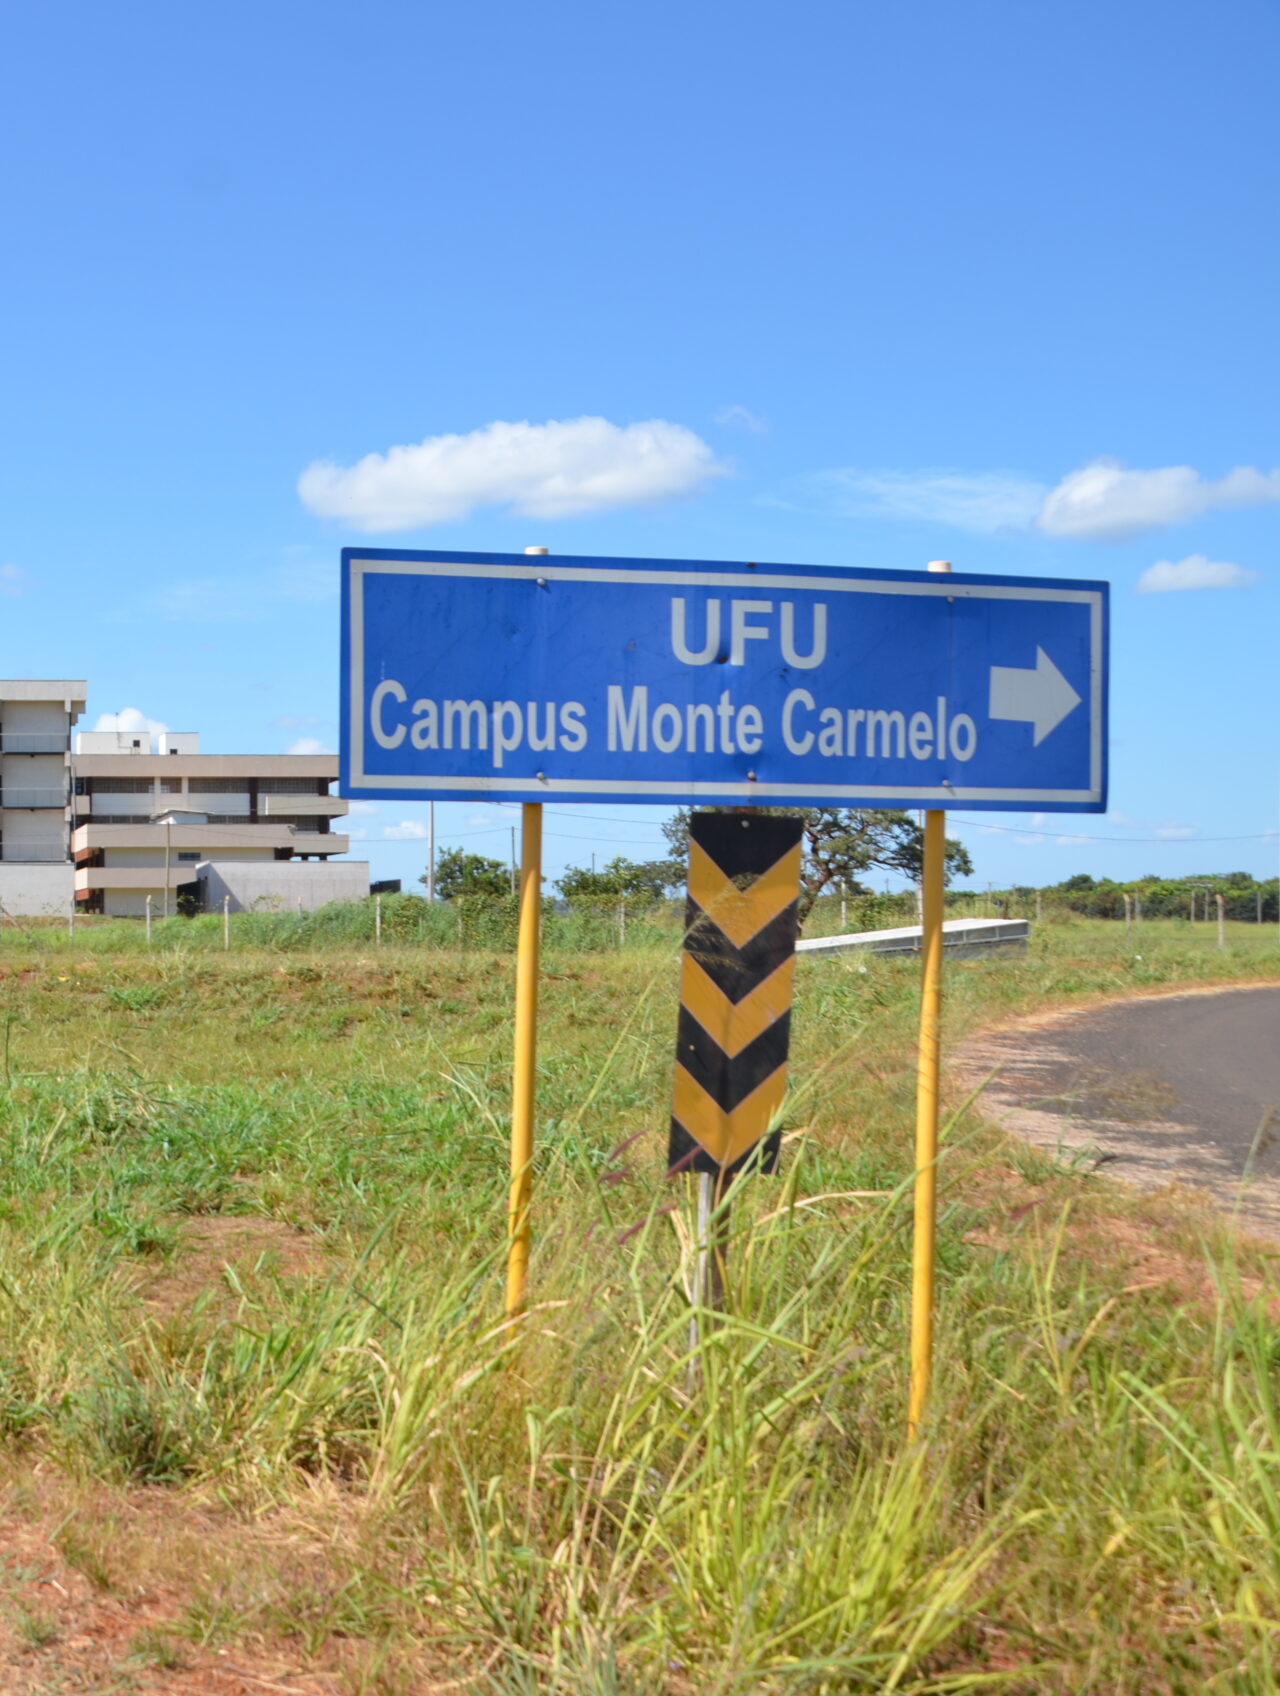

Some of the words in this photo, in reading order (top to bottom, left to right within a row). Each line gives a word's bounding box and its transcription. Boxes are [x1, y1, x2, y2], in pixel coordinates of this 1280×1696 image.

[671, 597, 827, 669] UFU
[370, 679, 588, 768] Campus
[607, 684, 763, 754] Monte
[782, 688, 977, 762] Carmelo
